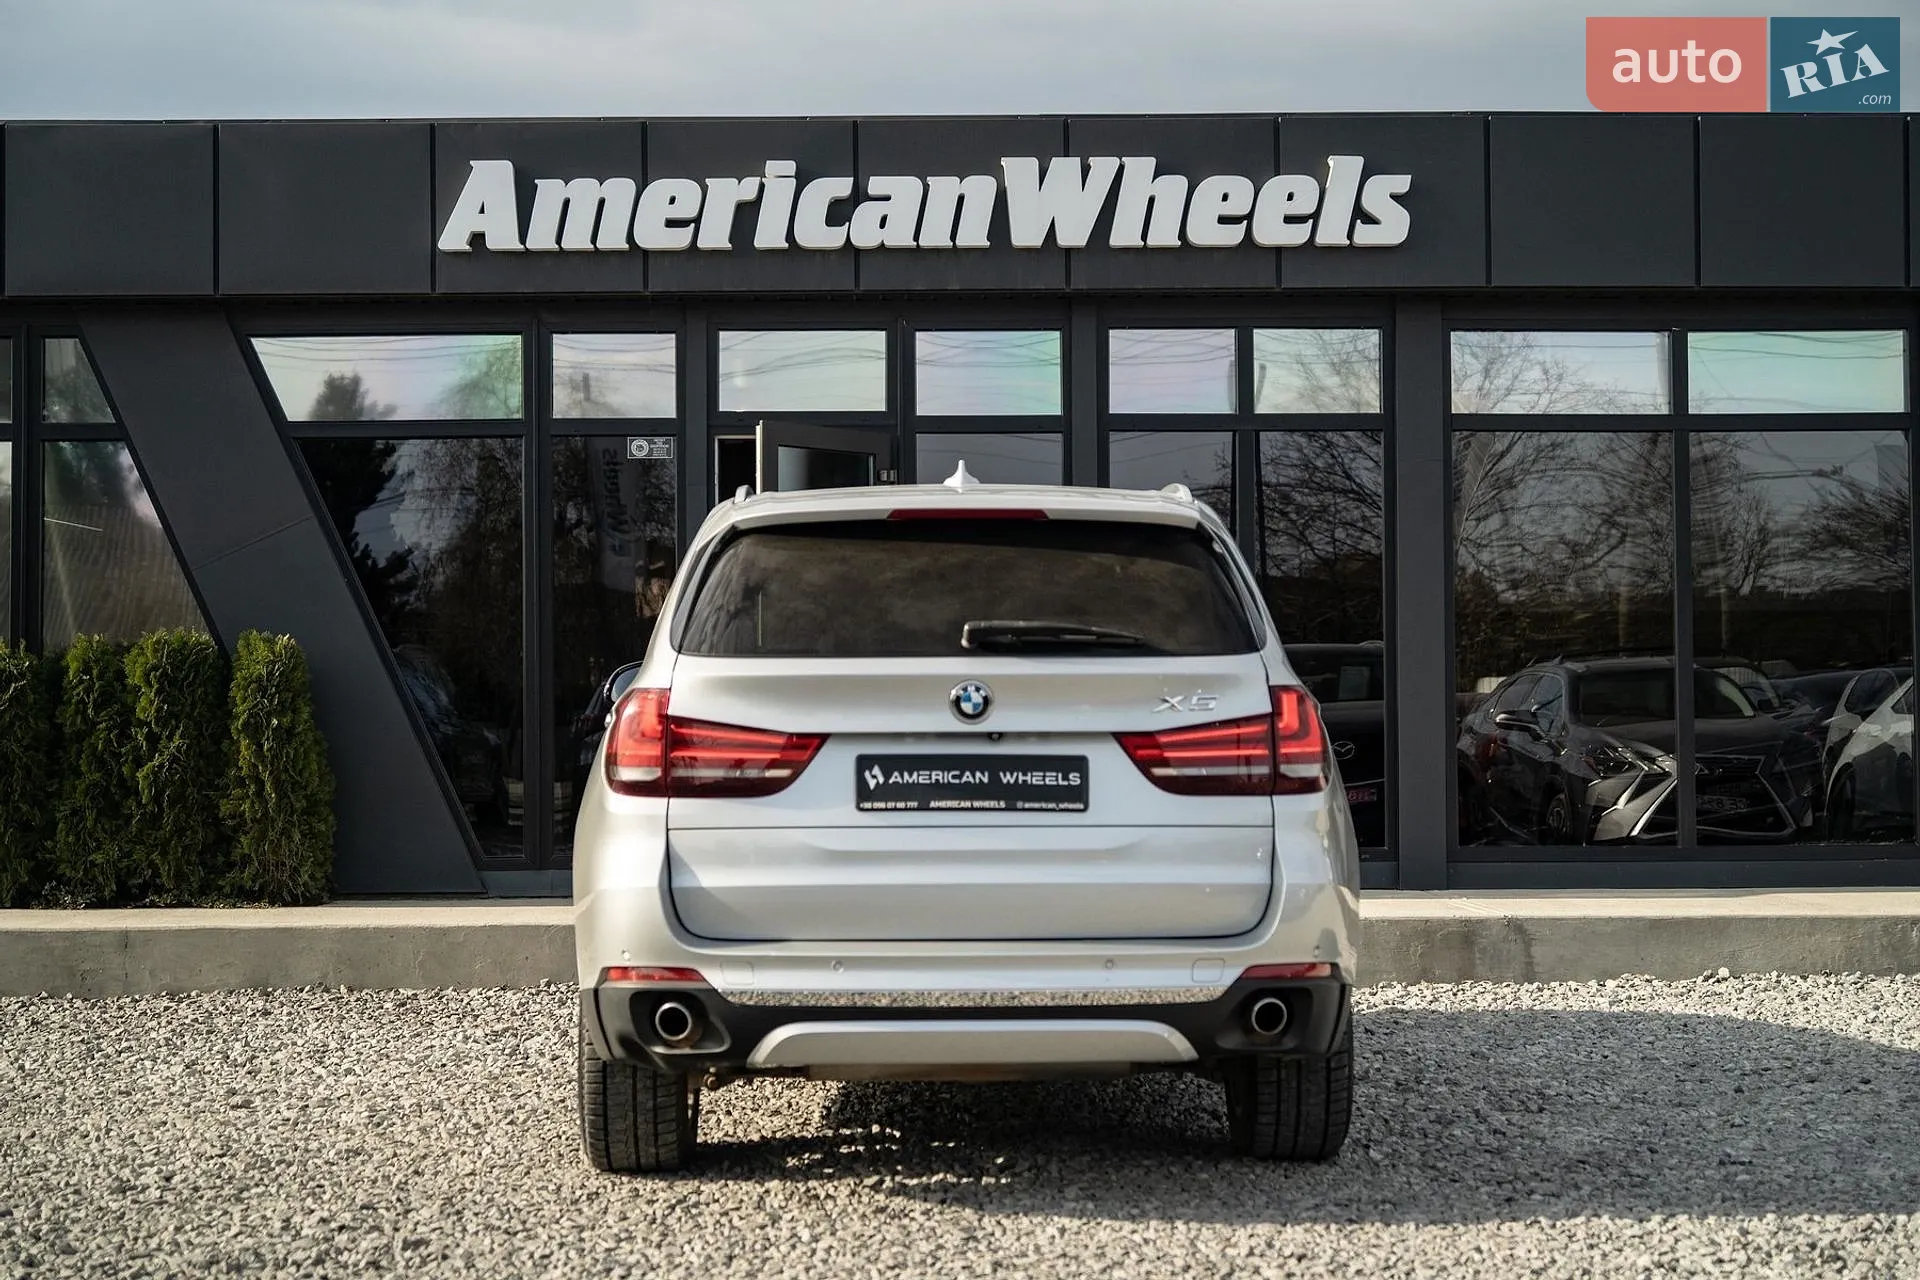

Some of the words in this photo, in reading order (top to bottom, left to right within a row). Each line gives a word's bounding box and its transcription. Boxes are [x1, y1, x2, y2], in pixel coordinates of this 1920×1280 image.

[1152, 695, 1219, 712] X5
[888, 770, 988, 784] AMERICAN
[1000, 771, 1081, 786] WHEELS
[930, 800, 971, 809] AMERICAN
[972, 800, 1006, 809] WHEELS
